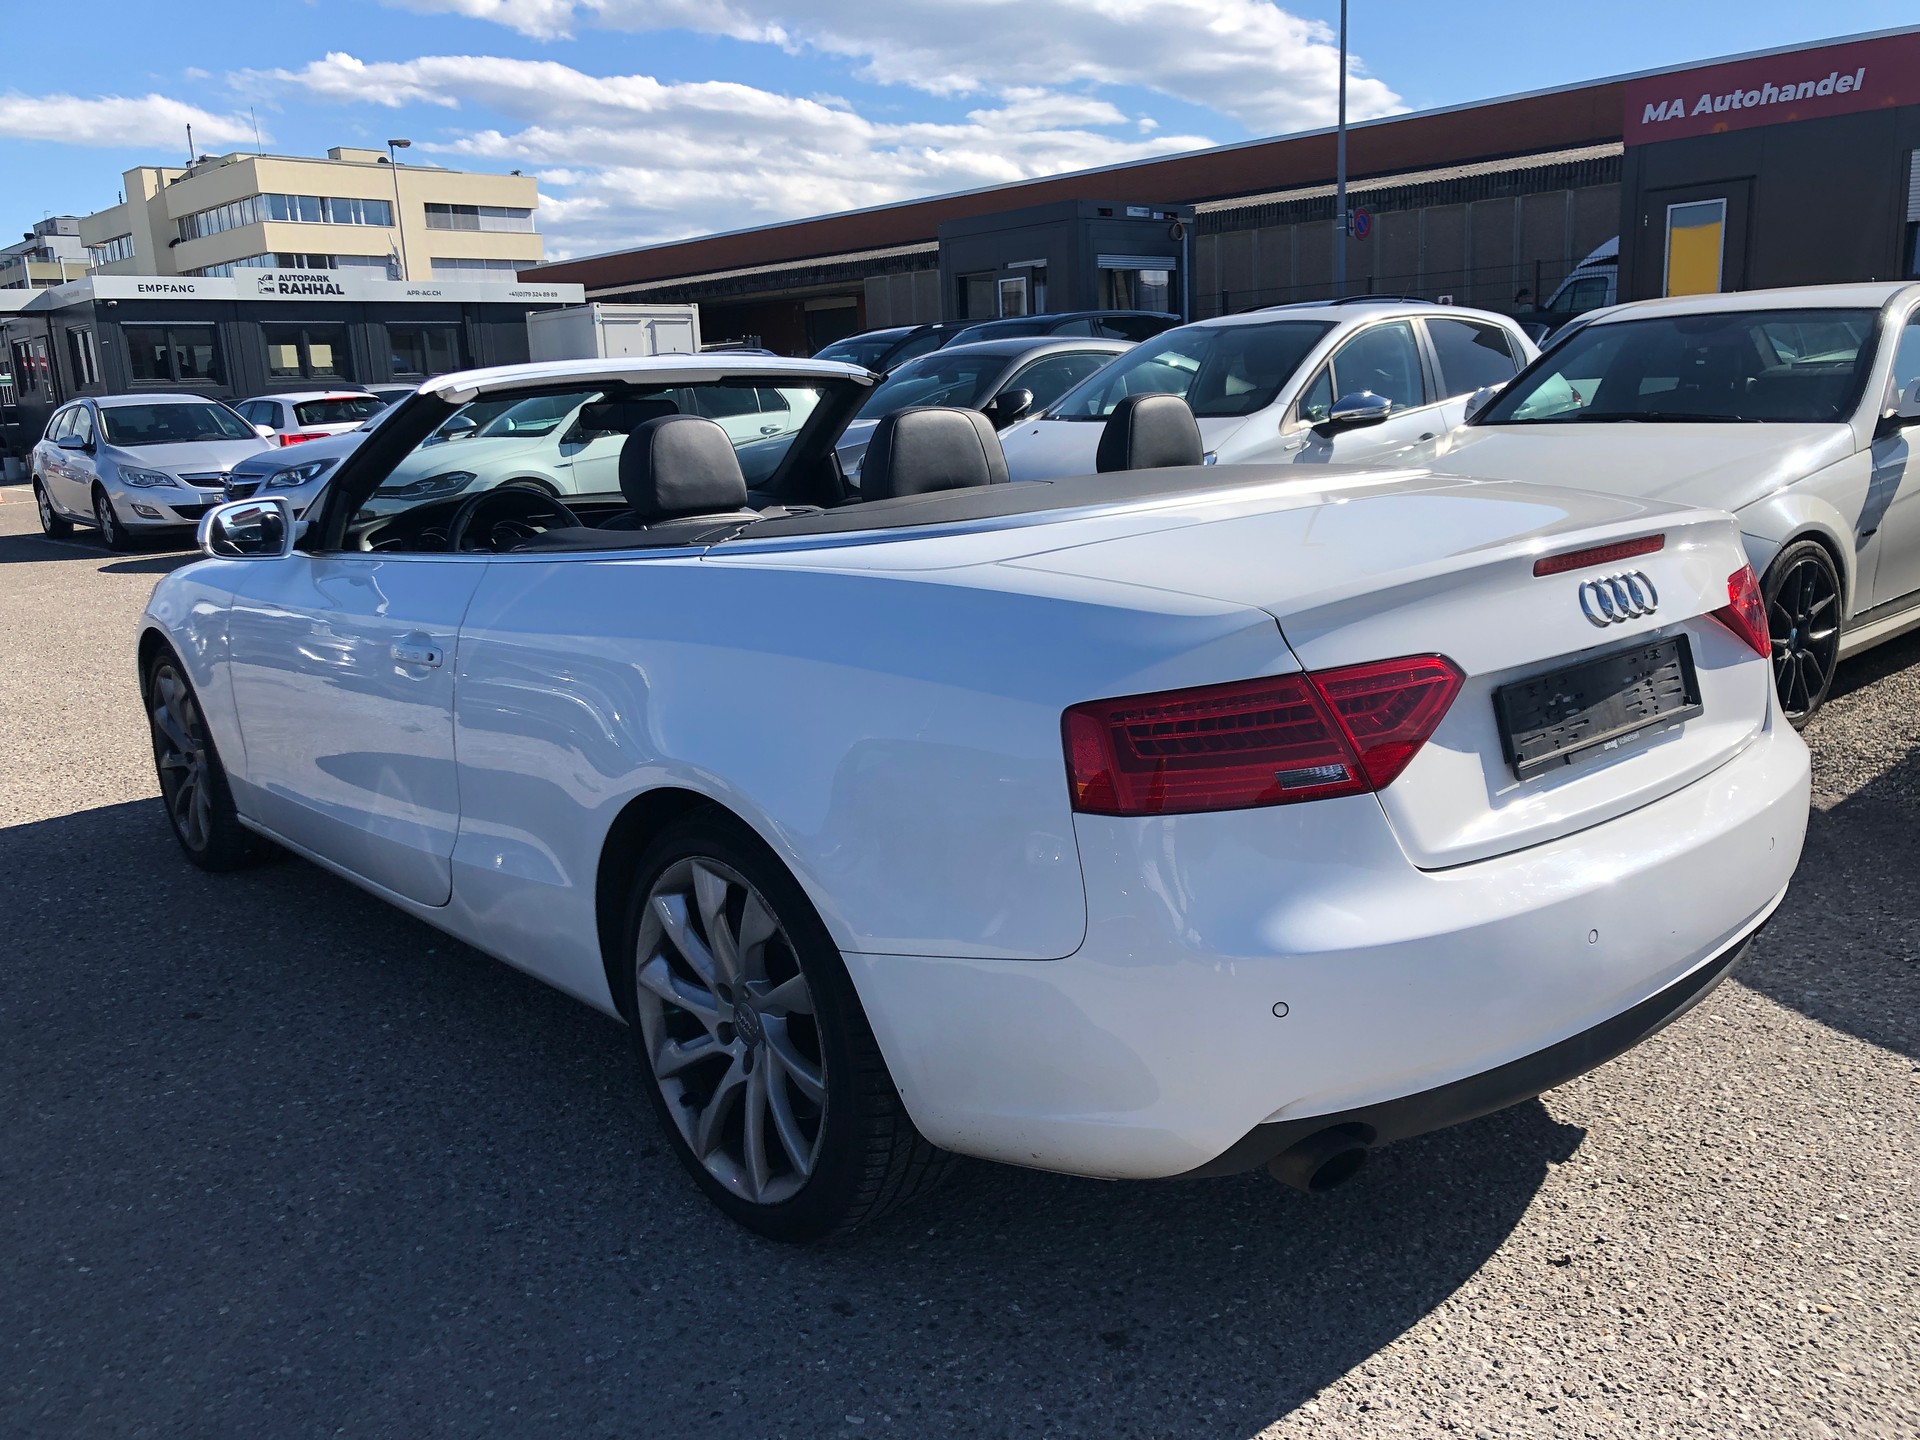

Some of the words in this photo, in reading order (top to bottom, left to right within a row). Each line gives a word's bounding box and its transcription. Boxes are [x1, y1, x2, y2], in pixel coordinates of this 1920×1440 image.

[1642, 98, 1685, 124] MA
[1691, 67, 1866, 116] Autohandel
[278, 274, 330, 283] AUTOPARK
[137, 284, 196, 293] EMPFANG
[279, 282, 345, 295] RAHHAL
